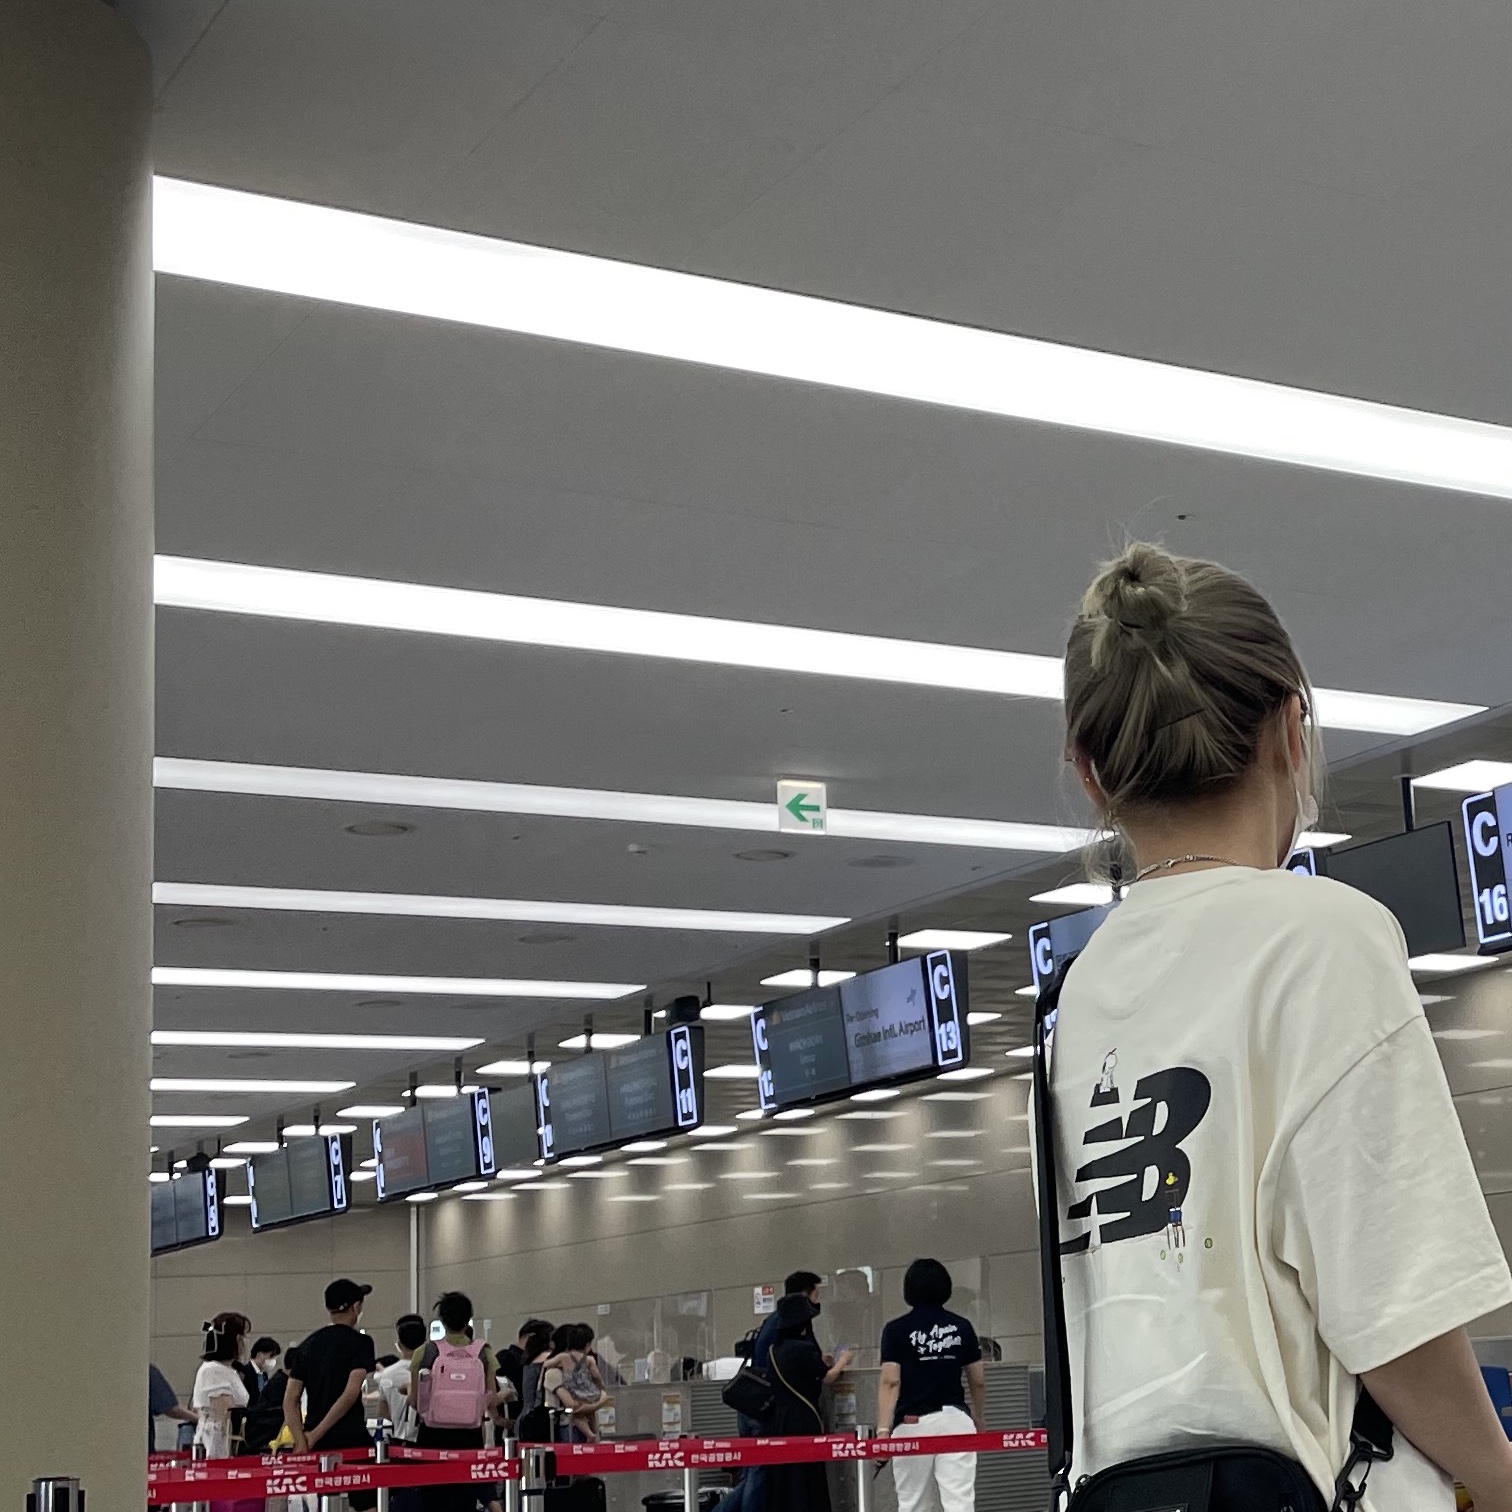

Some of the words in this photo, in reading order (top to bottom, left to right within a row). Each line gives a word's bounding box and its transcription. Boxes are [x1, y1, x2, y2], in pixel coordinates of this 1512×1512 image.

[1472, 811, 1499, 857] C
[1478, 884, 1509, 925] 16
[1036, 937, 1053, 975] C
[933, 964, 950, 1000] C
[938, 1021, 958, 1052] 13
[676, 1038, 688, 1070] C
[478, 1098, 488, 1125] C
[832, 1442, 866, 1457] KAC
[1003, 1433, 1036, 1447] KAC
[470, 1462, 509, 1478] KAC
[648, 1452, 686, 1467] KAC
[266, 1476, 307, 1494] KAC
